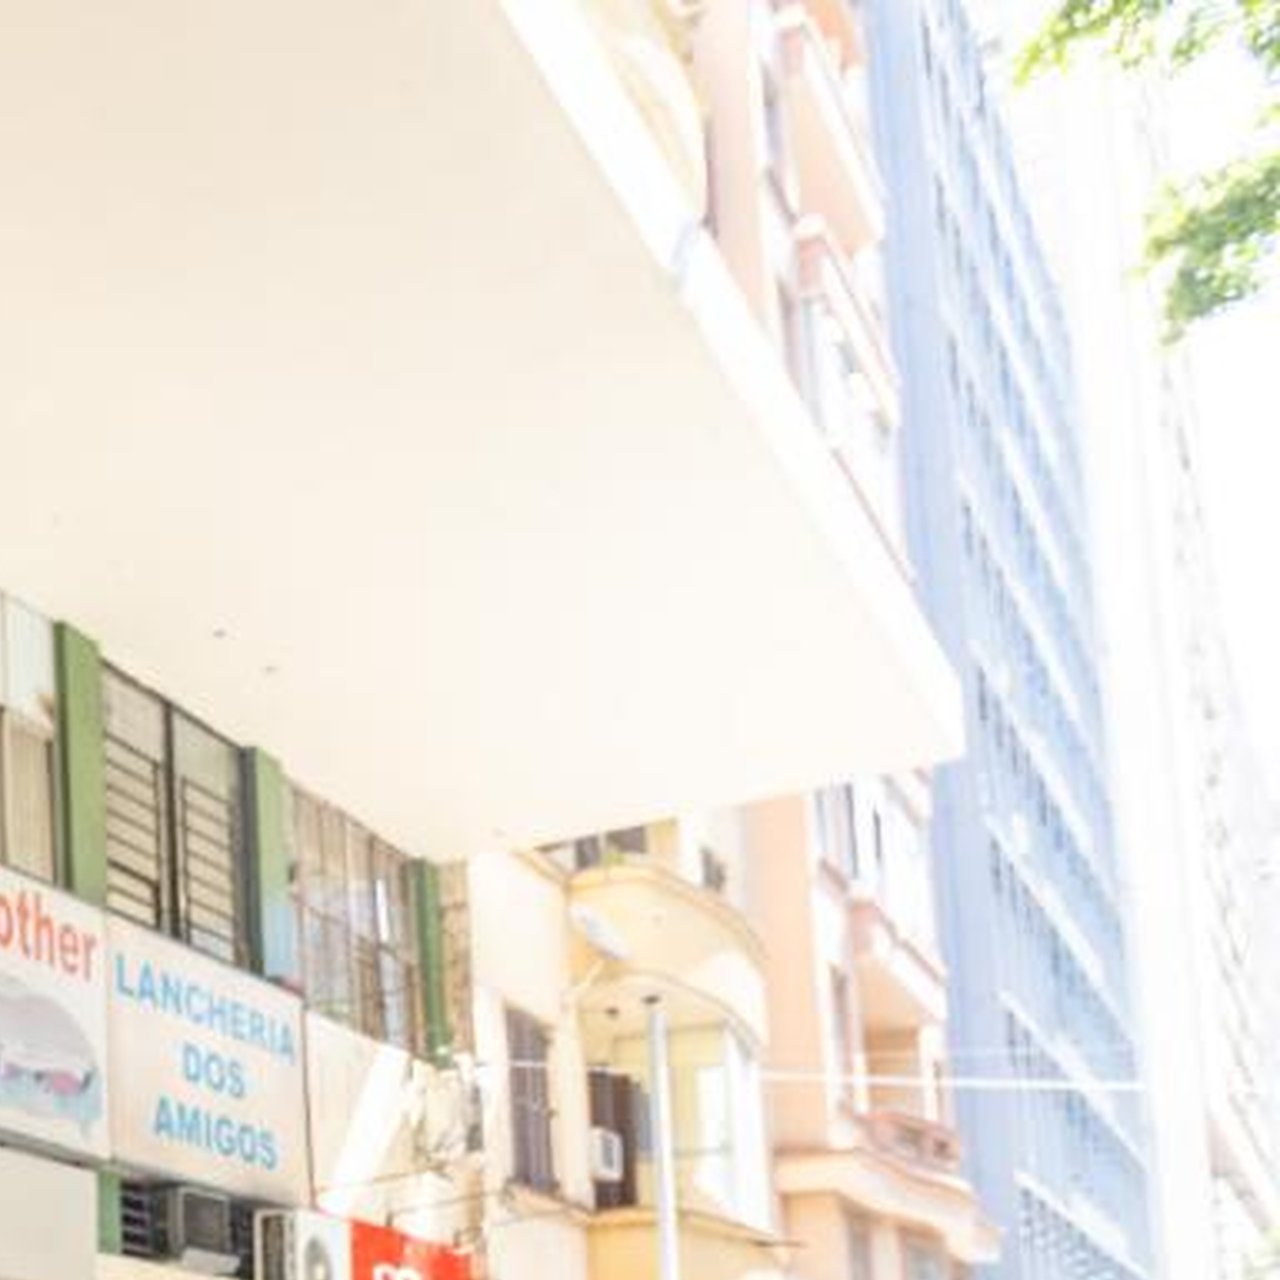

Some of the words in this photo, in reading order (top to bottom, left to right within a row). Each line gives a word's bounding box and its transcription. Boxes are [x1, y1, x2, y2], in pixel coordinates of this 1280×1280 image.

[114, 953, 296, 1066] LANCHERIA
[183, 1041, 246, 1100] DOS
[153, 1094, 278, 1172] AMIGOS
